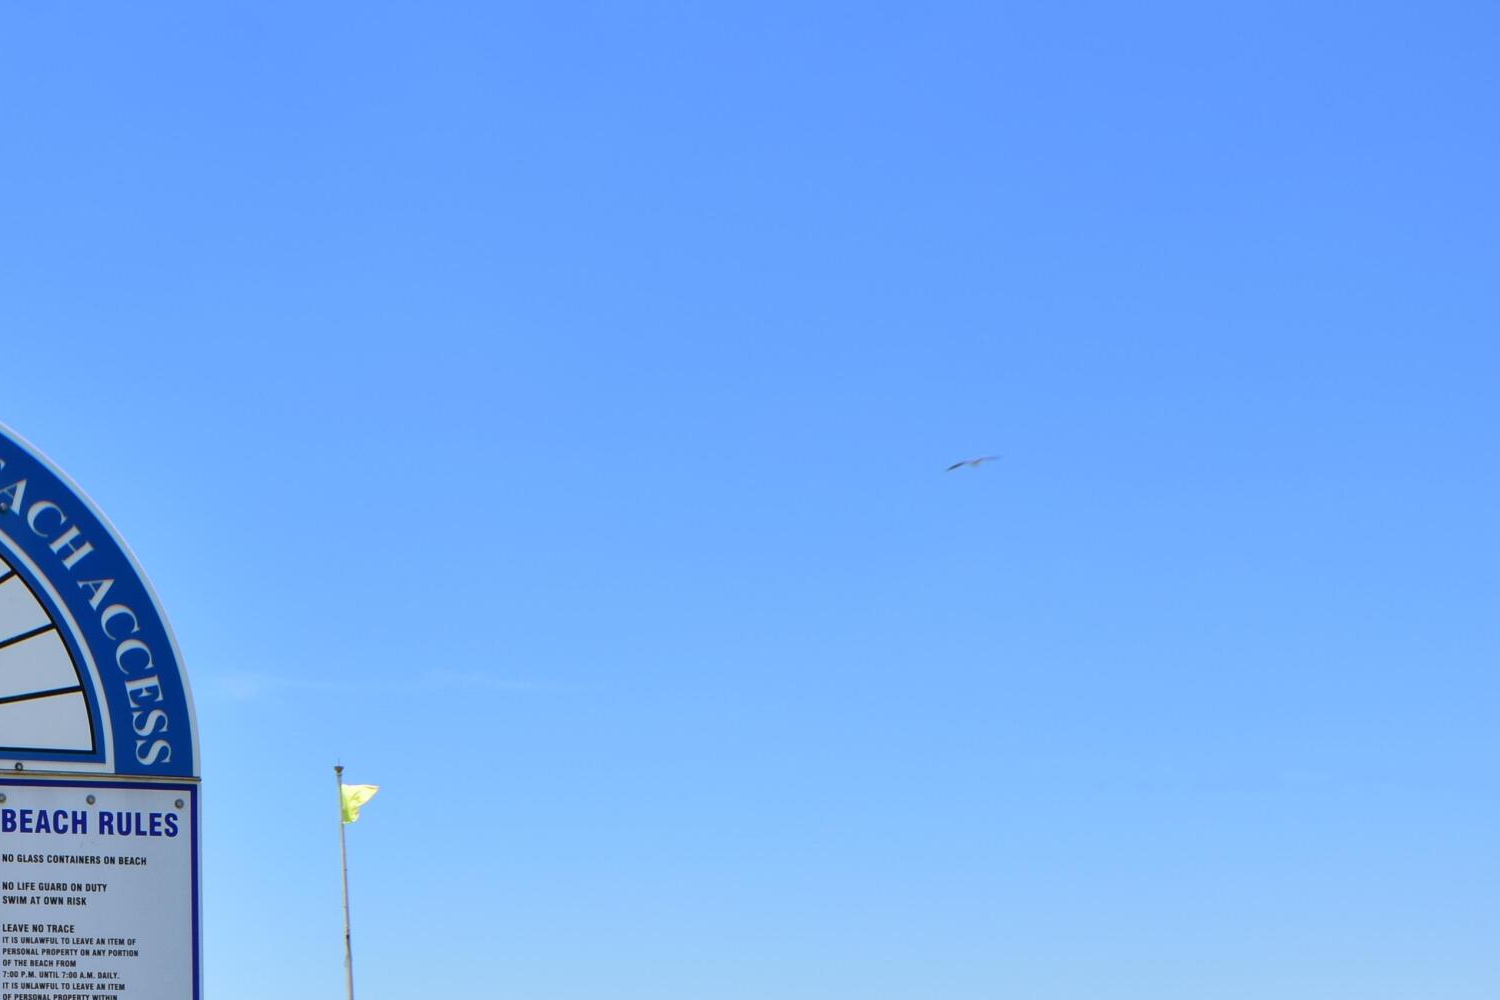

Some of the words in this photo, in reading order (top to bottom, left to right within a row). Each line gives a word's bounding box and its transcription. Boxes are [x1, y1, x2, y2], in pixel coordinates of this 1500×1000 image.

[77, 578, 172, 766] ACCESS
[1, 808, 87, 835] BEACH
[98, 810, 178, 838] RULES
[2, 853, 14, 863] NO
[17, 853, 44, 864] GLASS
[46, 854, 101, 864] CONTAINERS
[103, 855, 115, 865] ON
[118, 855, 147, 865] BEACH
[2, 881, 14, 891] NO
[17, 881, 35, 891] LIFE
[38, 882, 67, 892] GUARD
[70, 882, 82, 892] ON
[85, 883, 107, 892] DUTY
[2, 895, 27, 905] SWIM
[30, 896, 40, 905] AT
[43, 896, 63, 905] OWN
[66, 896, 86, 906] RISK
[2, 923, 29, 933] LEAVE
[32, 924, 44, 933] NO
[47, 924, 74, 933] TRACE
[2, 936, 9, 944] IT
[61, 937, 70, 945] TO
[72, 937, 93, 945] LEAVE
[127, 938, 136, 946] OF
[41, 948, 78, 956] PROPERTY
[108, 949, 139, 957] PORTION
[29, 959, 54, 967] BEACH
[3, 970, 19, 978] 7:00
[20, 970, 36, 978] P.M.
[79, 971, 95, 979] A.M.
[97, 971, 119, 979] DAILY.
